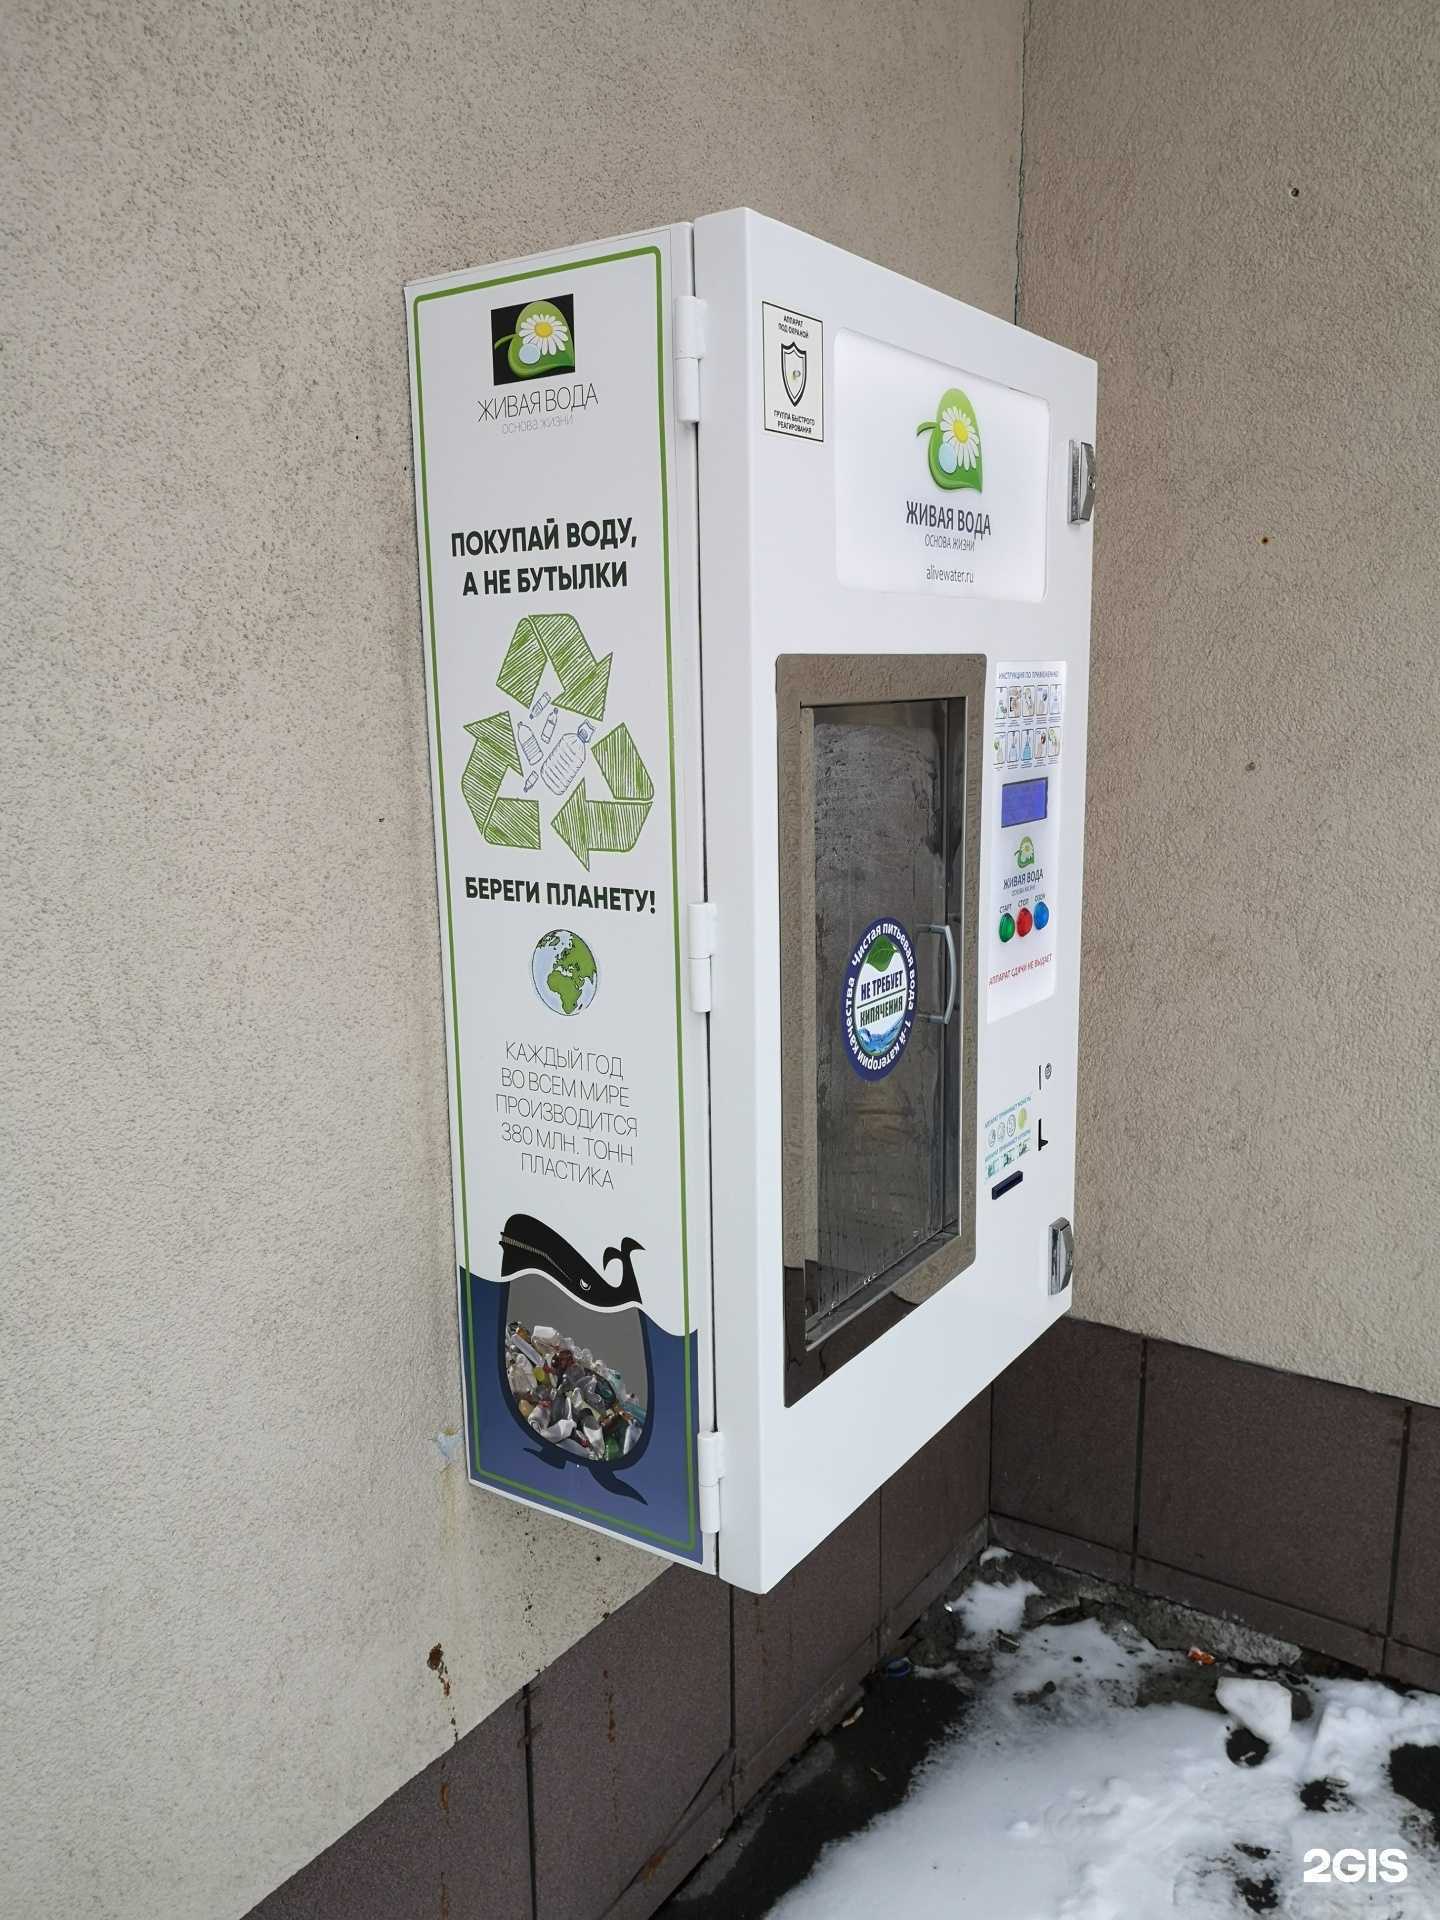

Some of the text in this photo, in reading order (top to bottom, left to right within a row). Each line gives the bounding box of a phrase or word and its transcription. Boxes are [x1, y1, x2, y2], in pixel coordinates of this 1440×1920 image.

[477, 383, 599, 423] ЖИВАЯ ВОДА
[451, 517, 637, 558] ПОКУПАЙ ВОДУ,
[906, 500, 991, 541] ЖИВАЯ ВОДА
[924, 534, 975, 552] ОСНОВА ЖИЗНИ
[462, 561, 628, 596] А НЕ БУТЫЛКИ
[926, 564, 974, 583] alivewater.ru
[465, 876, 656, 914] БЕРЕГИ ПЛАНЕТУ!
[1003, 869, 1044, 889] ЖИВАЯ ВОДА
[852, 925, 881, 966] Чистая
[883, 923, 914, 968] питьевая
[861, 971, 903, 1000] НЕ ТРЕБУЕТ
[908, 969, 916, 1011] вода
[845, 977, 860, 1054] качества
[860, 996, 903, 1027] КИПЯЧЕНИЯ
[505, 1041, 624, 1081] КАЖДЫЙ ГОД
[857, 1042, 900, 1071] категории
[501, 1067, 630, 1108] ВО ВСЕМ МИРЕ
[496, 1093, 638, 1137] ПРОИЗВОДИТСЯ
[501, 1122, 634, 1165] 380 МЛН. ТОНН
[521, 1152, 615, 1190] ПЛАСТИКА
